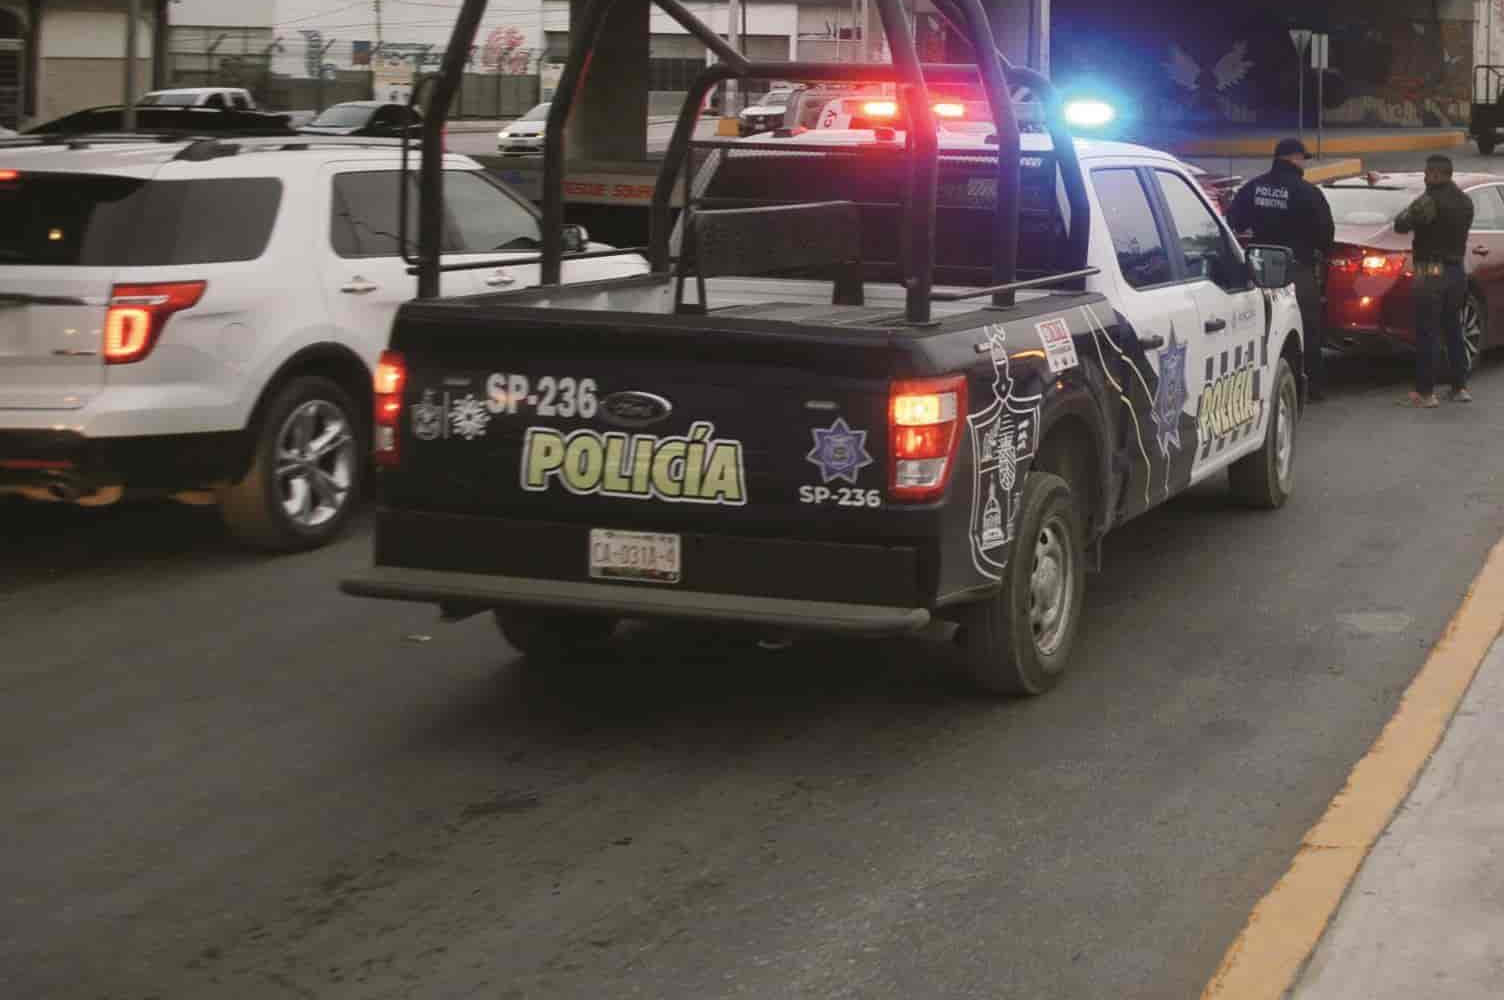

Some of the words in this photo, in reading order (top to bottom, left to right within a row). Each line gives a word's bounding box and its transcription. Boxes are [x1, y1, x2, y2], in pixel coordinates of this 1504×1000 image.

[486, 373, 598, 419] SP-236
[521, 421, 747, 505] POLICÍA
[799, 485, 881, 508] SP-236
